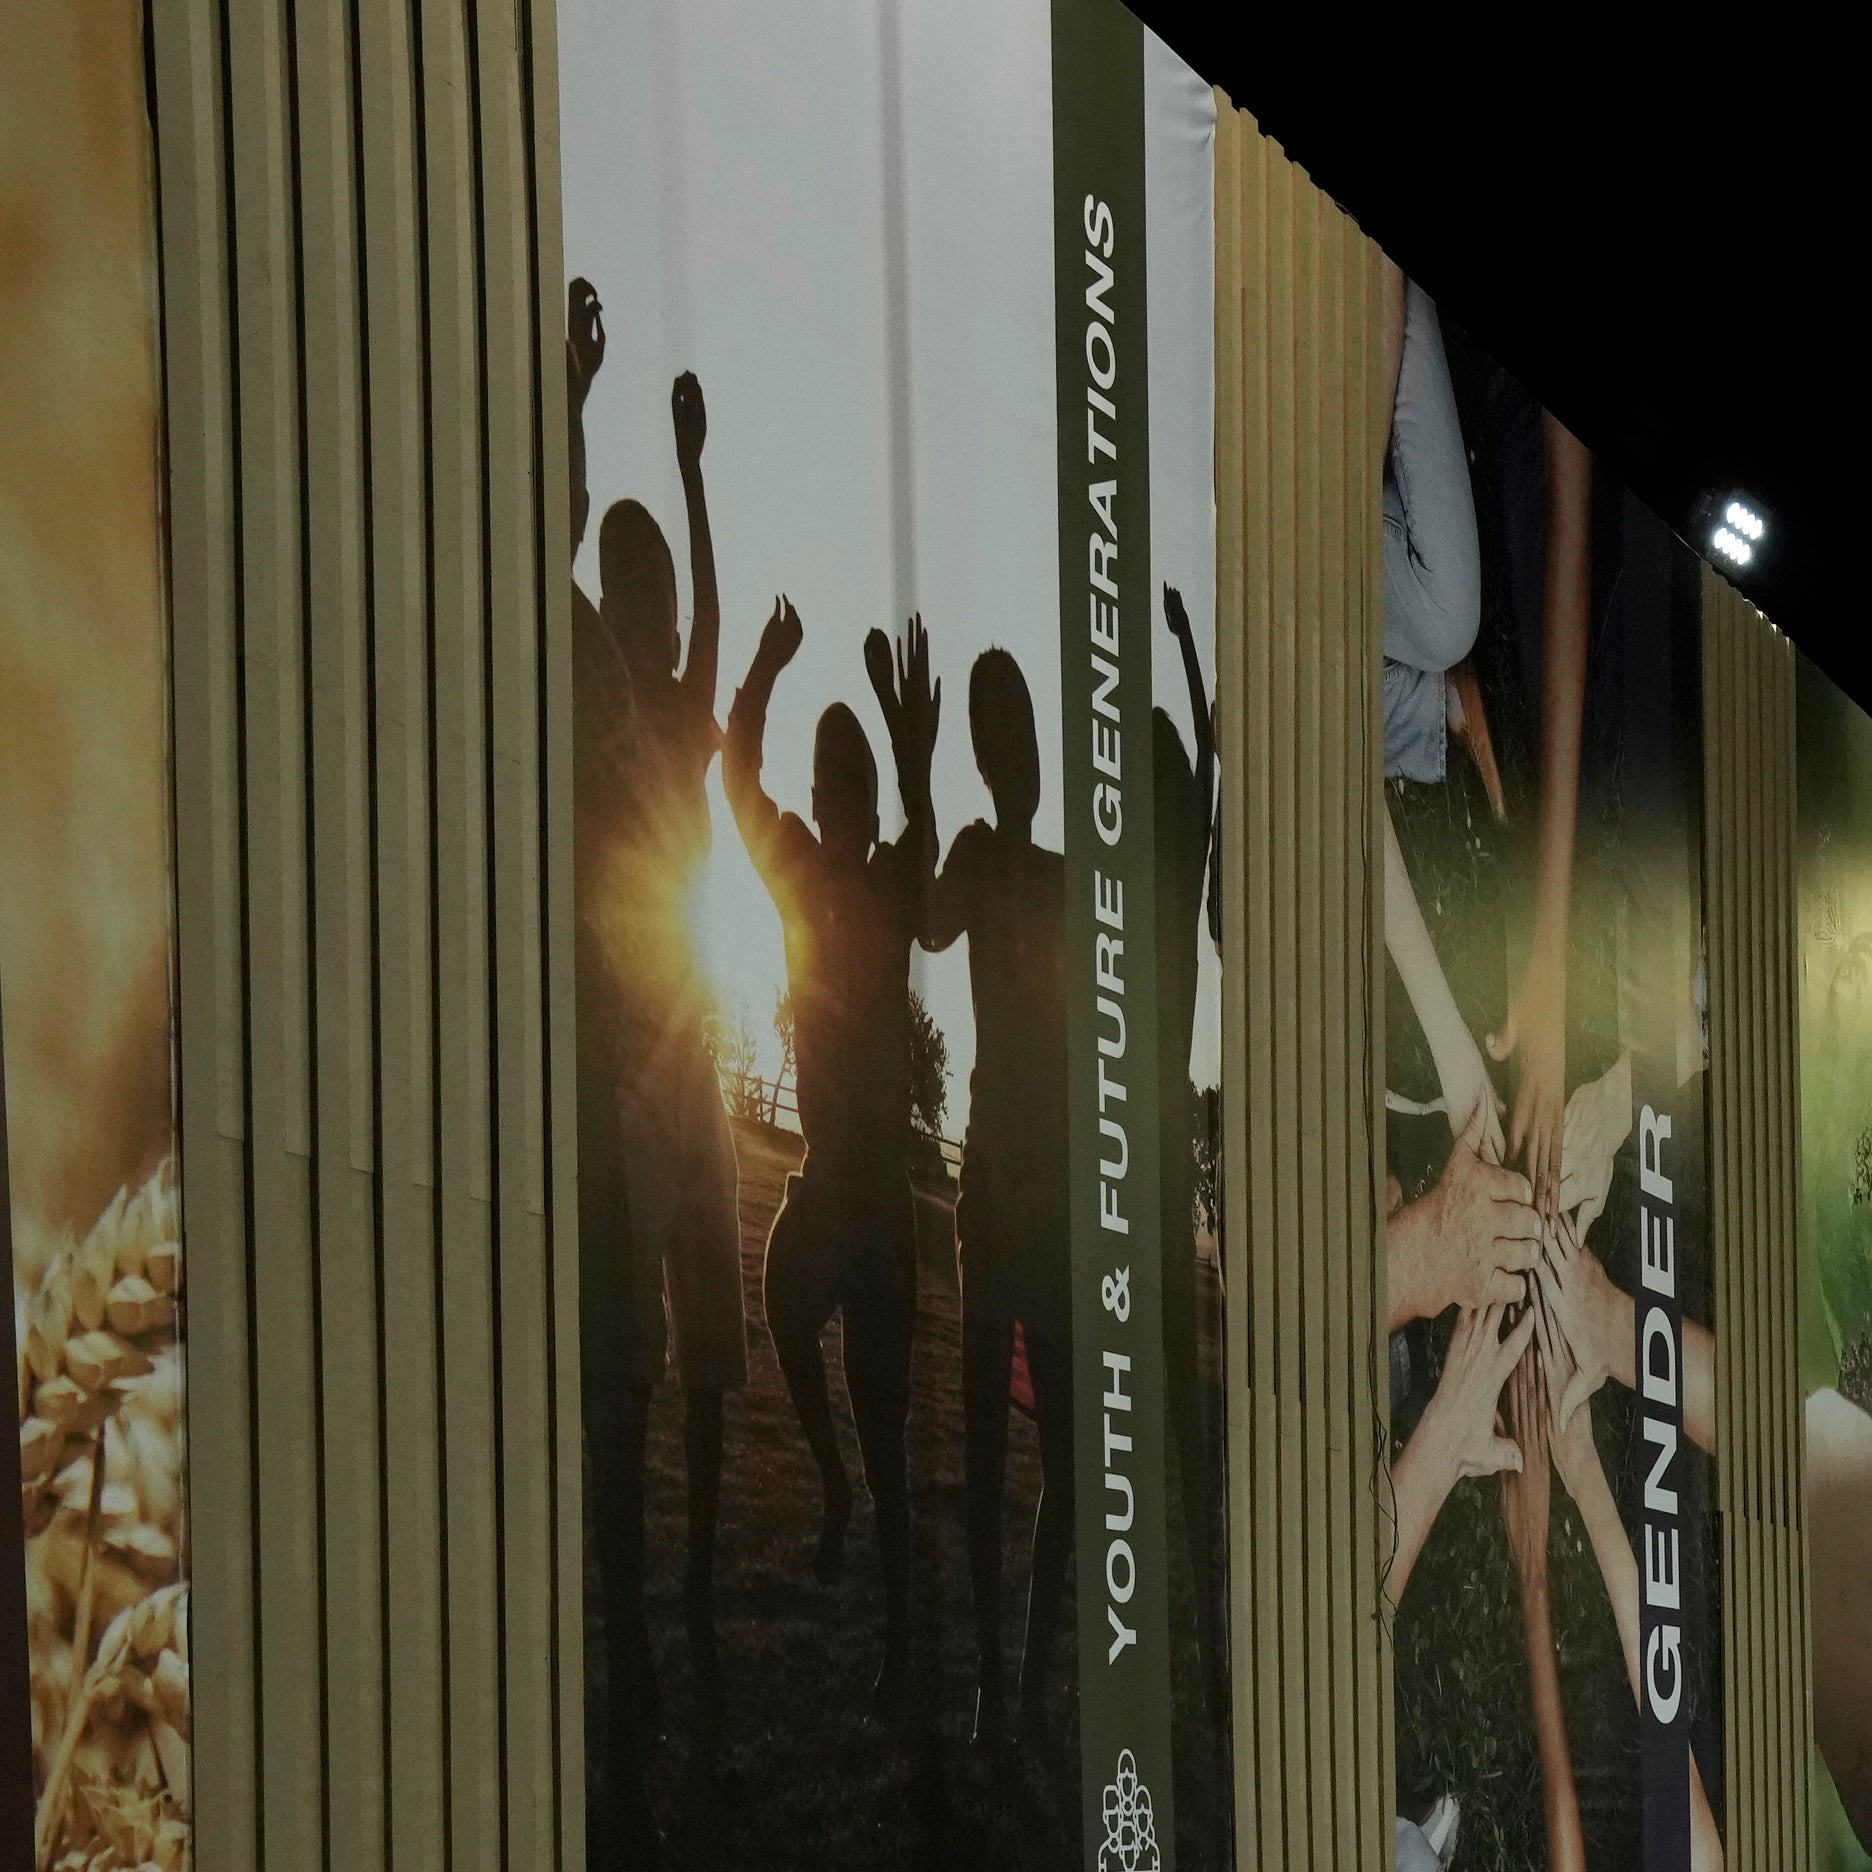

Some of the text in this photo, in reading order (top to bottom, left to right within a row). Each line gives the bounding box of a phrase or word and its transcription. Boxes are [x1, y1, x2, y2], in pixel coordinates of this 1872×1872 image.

[1083, 193, 1137, 1667] YOUTH & FUTURE GENERATIONS
[1639, 1103, 1682, 1725] GENDER
